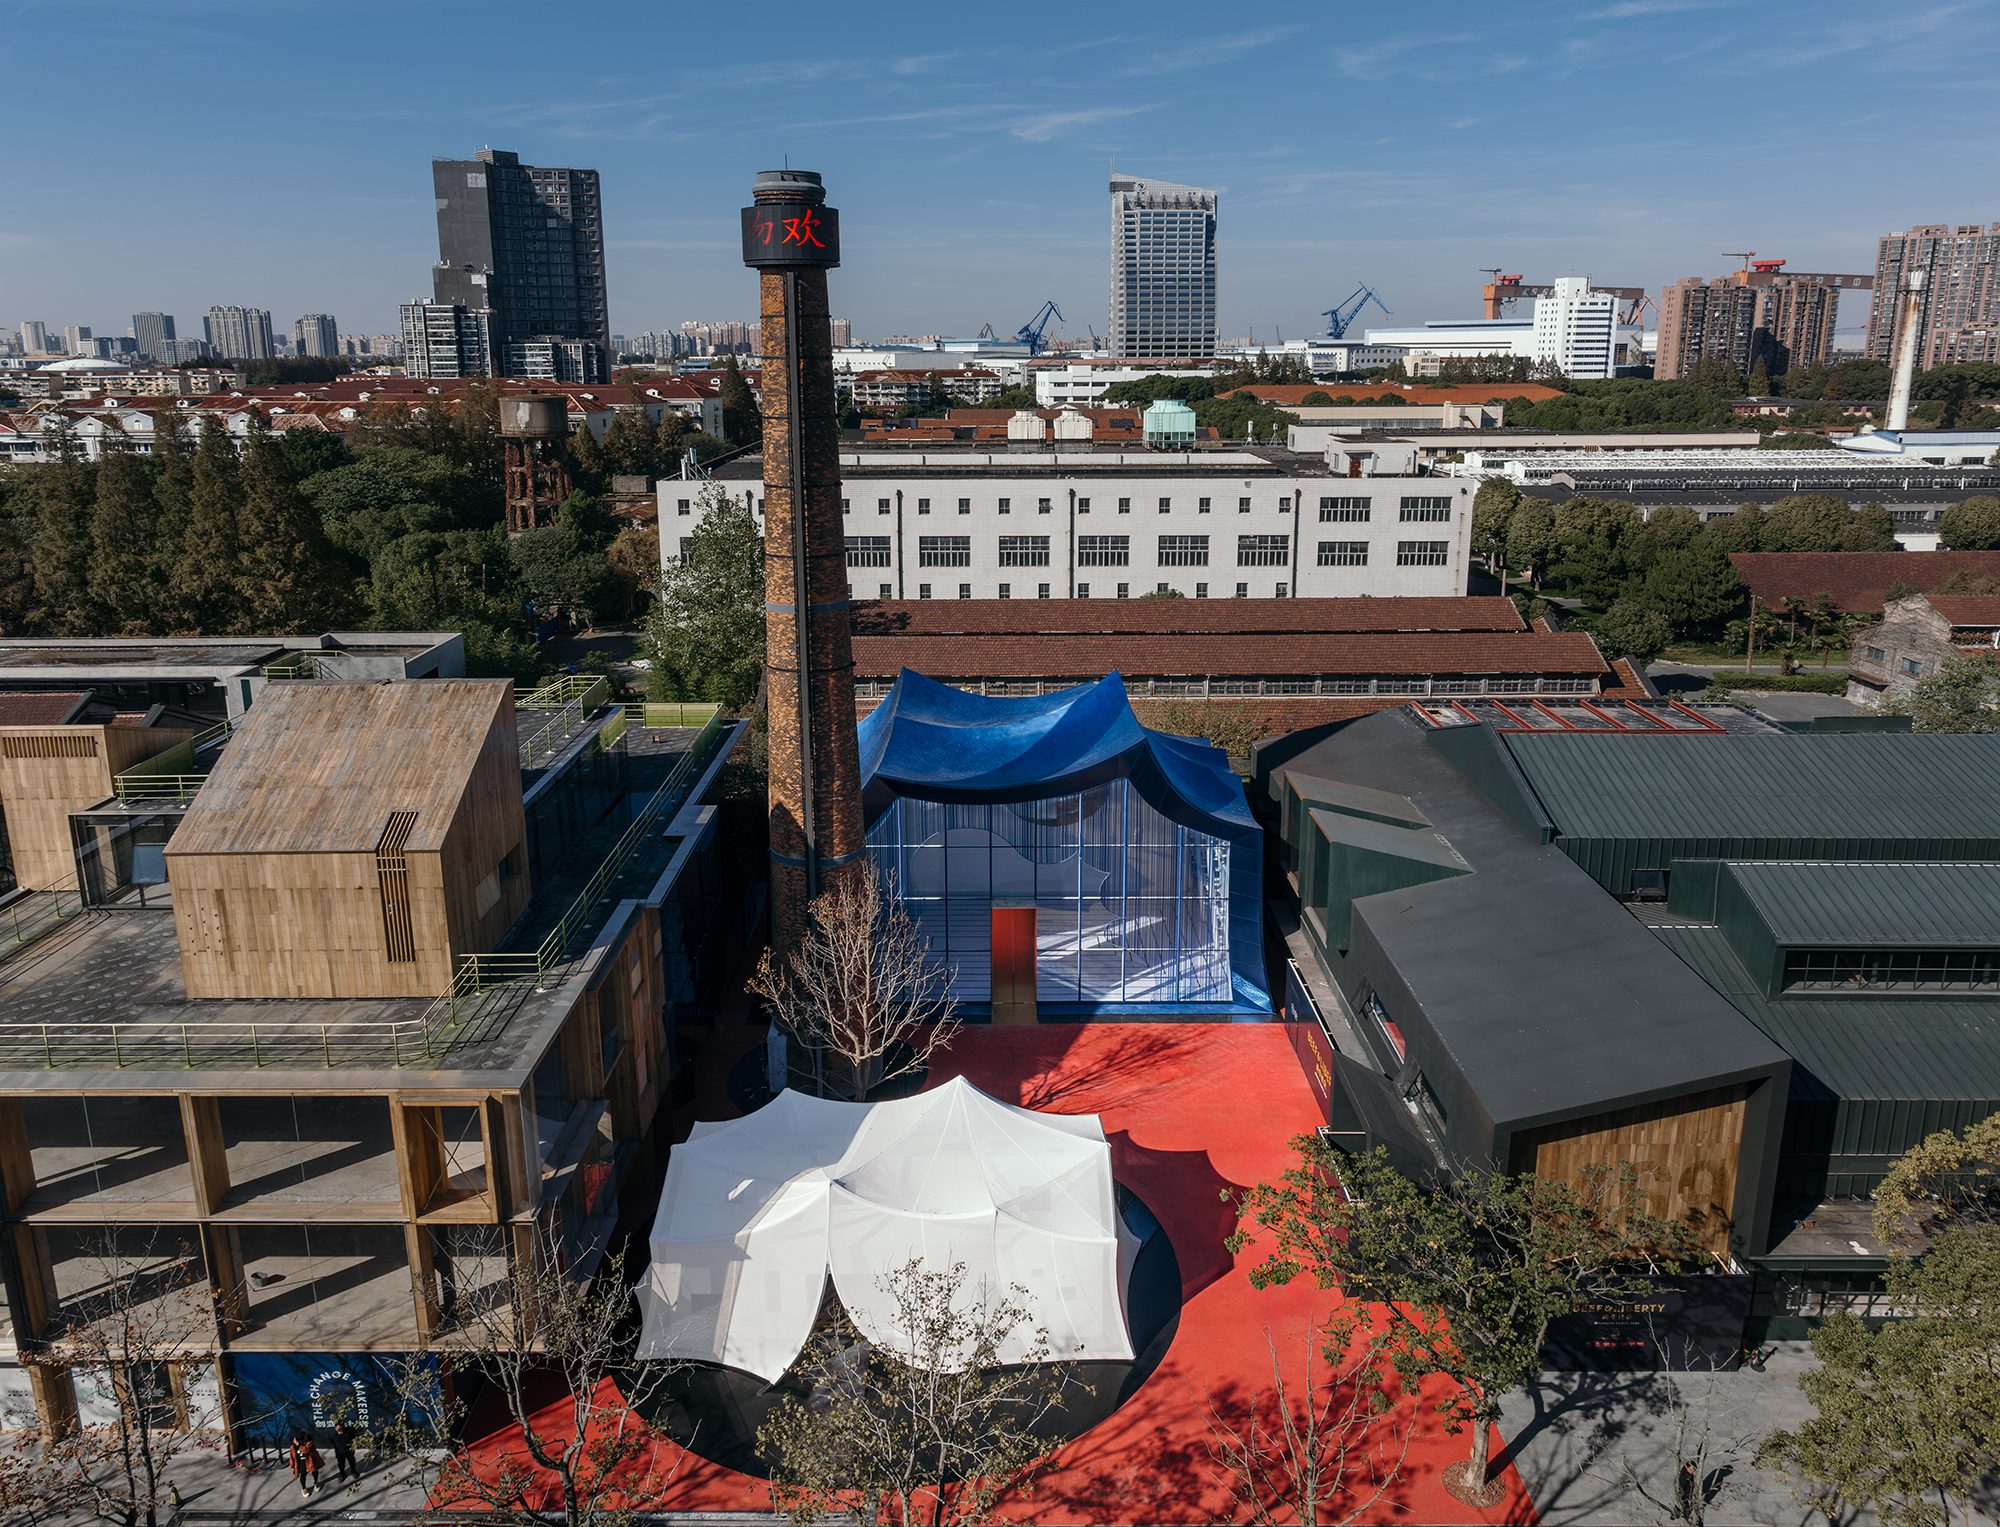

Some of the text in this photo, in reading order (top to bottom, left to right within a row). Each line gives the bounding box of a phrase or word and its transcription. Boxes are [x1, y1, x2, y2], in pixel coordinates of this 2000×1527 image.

[309, 1370, 369, 1424] THE CHANGE MAKERS
